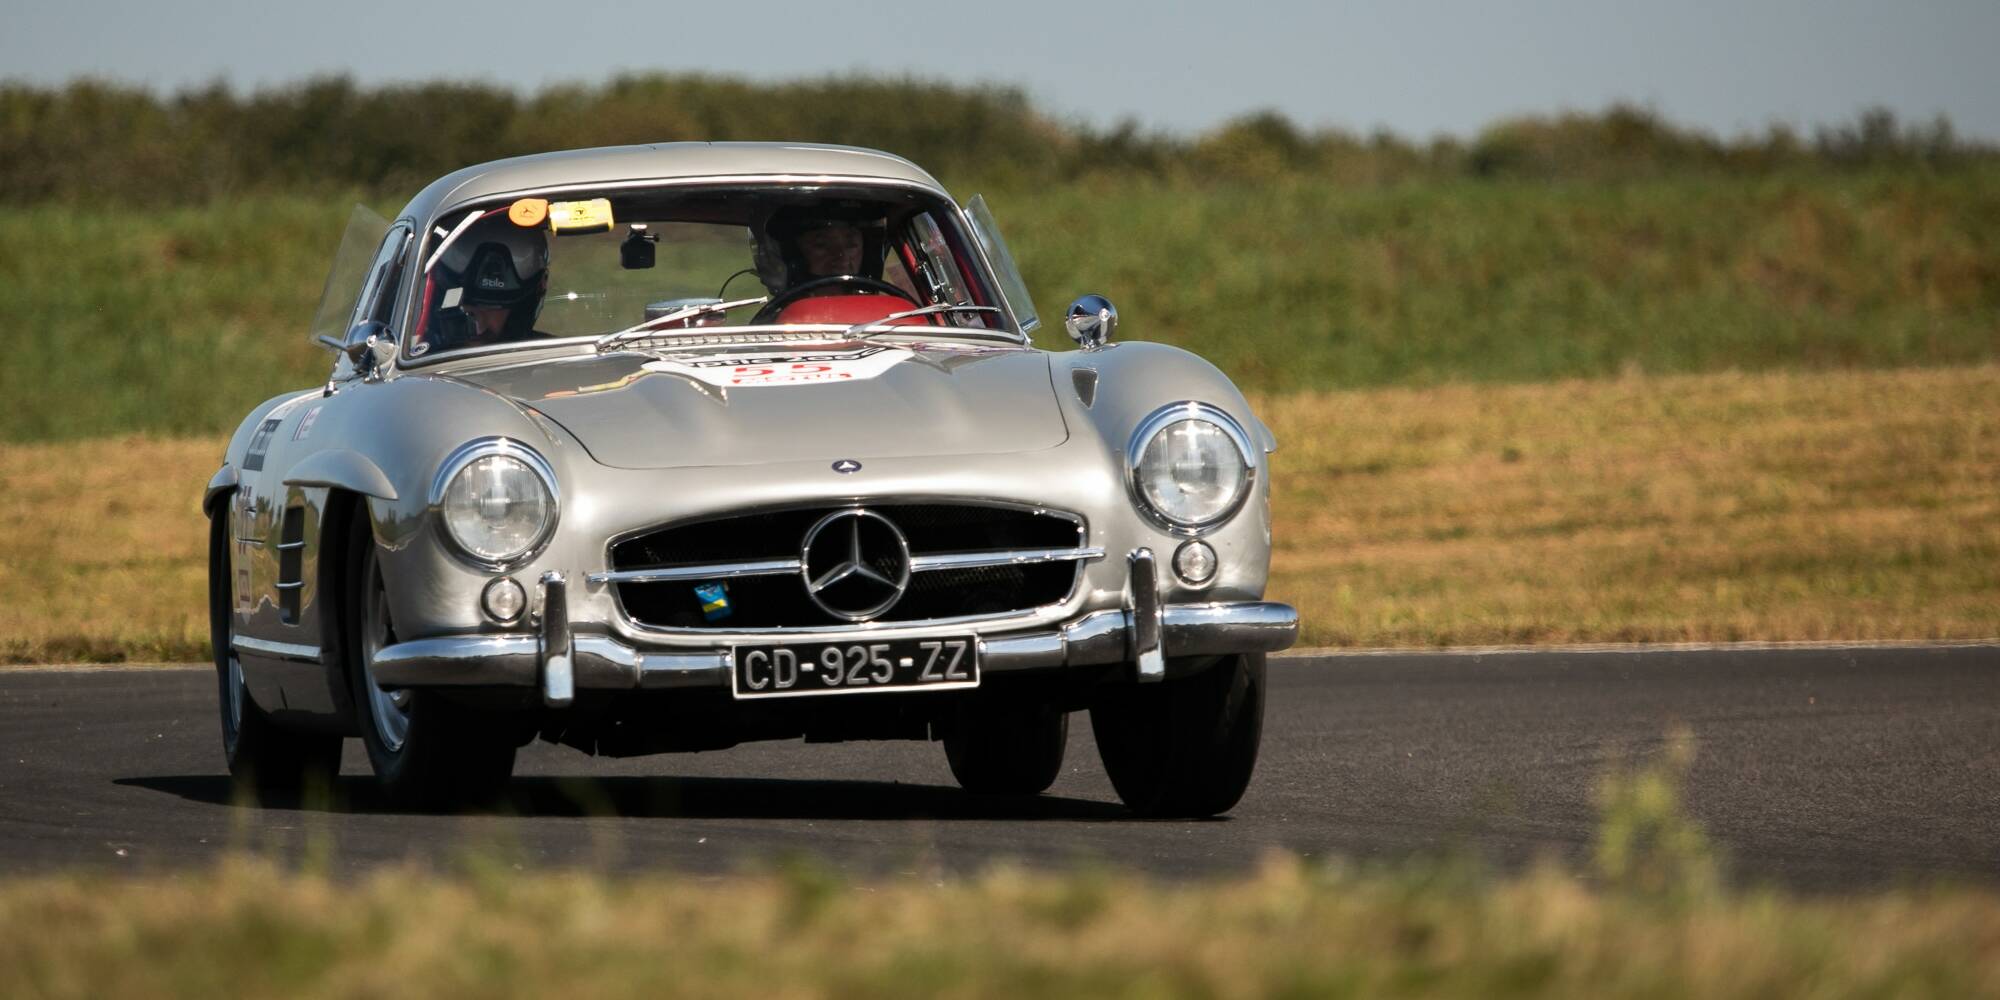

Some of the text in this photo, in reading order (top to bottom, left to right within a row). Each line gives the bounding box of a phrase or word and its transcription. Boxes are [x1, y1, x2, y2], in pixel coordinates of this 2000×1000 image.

[690, 358, 773, 368] ptic
[733, 364, 832, 377] 55
[745, 641, 967, 690] CD-925-ZZ
